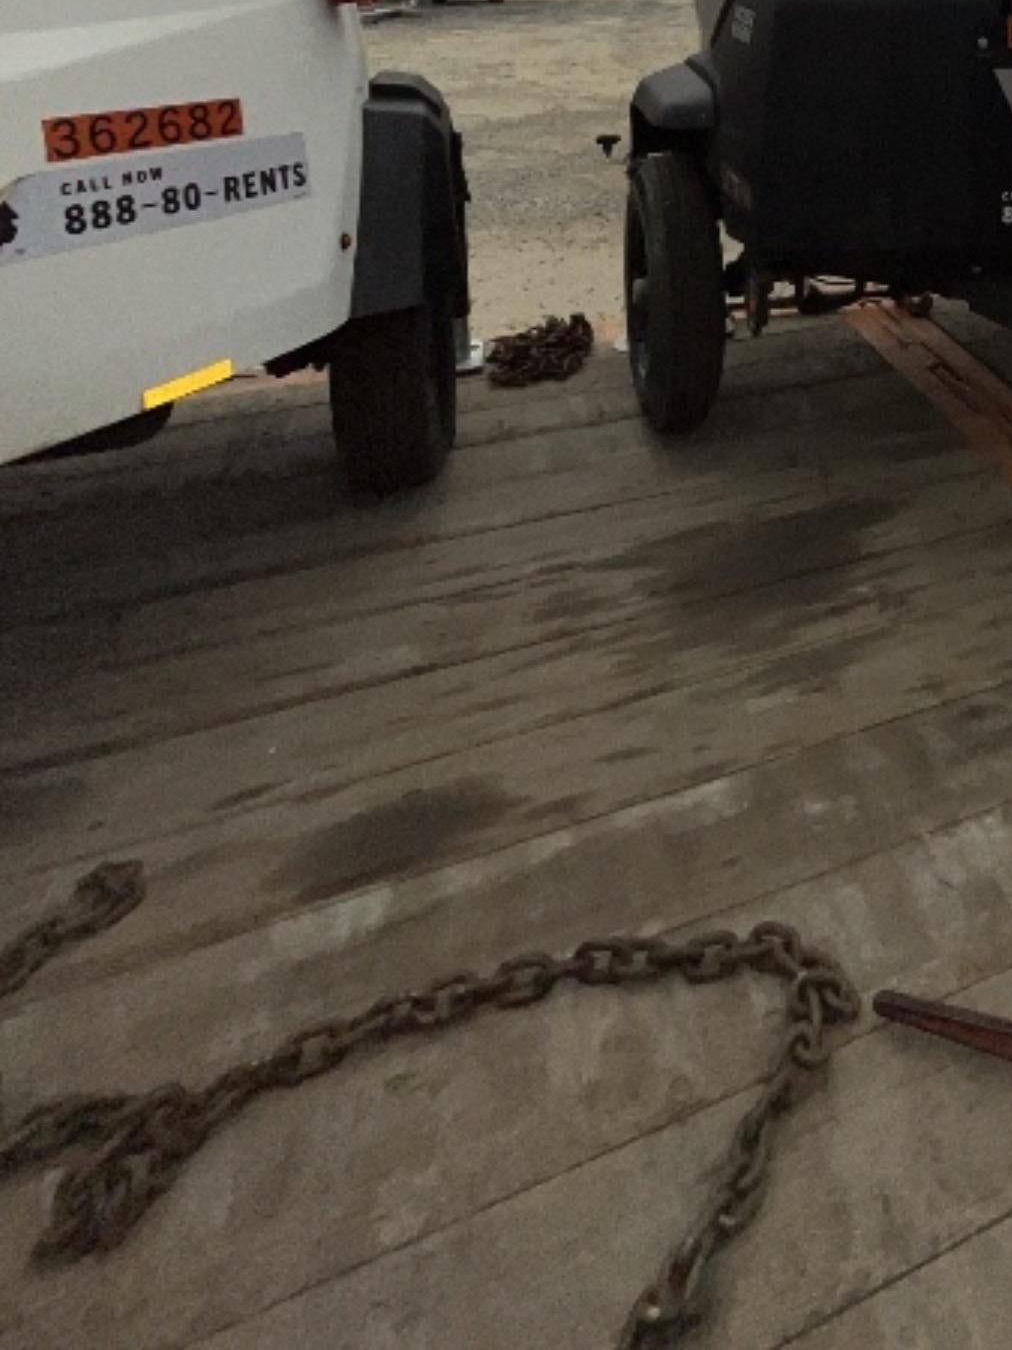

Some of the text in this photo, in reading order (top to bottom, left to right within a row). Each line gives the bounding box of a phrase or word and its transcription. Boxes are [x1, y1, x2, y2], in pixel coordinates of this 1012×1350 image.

[51, 99, 238, 159] 362682
[60, 167, 163, 196] CALL NOW
[64, 162, 307, 235] 888-80-RENTS
